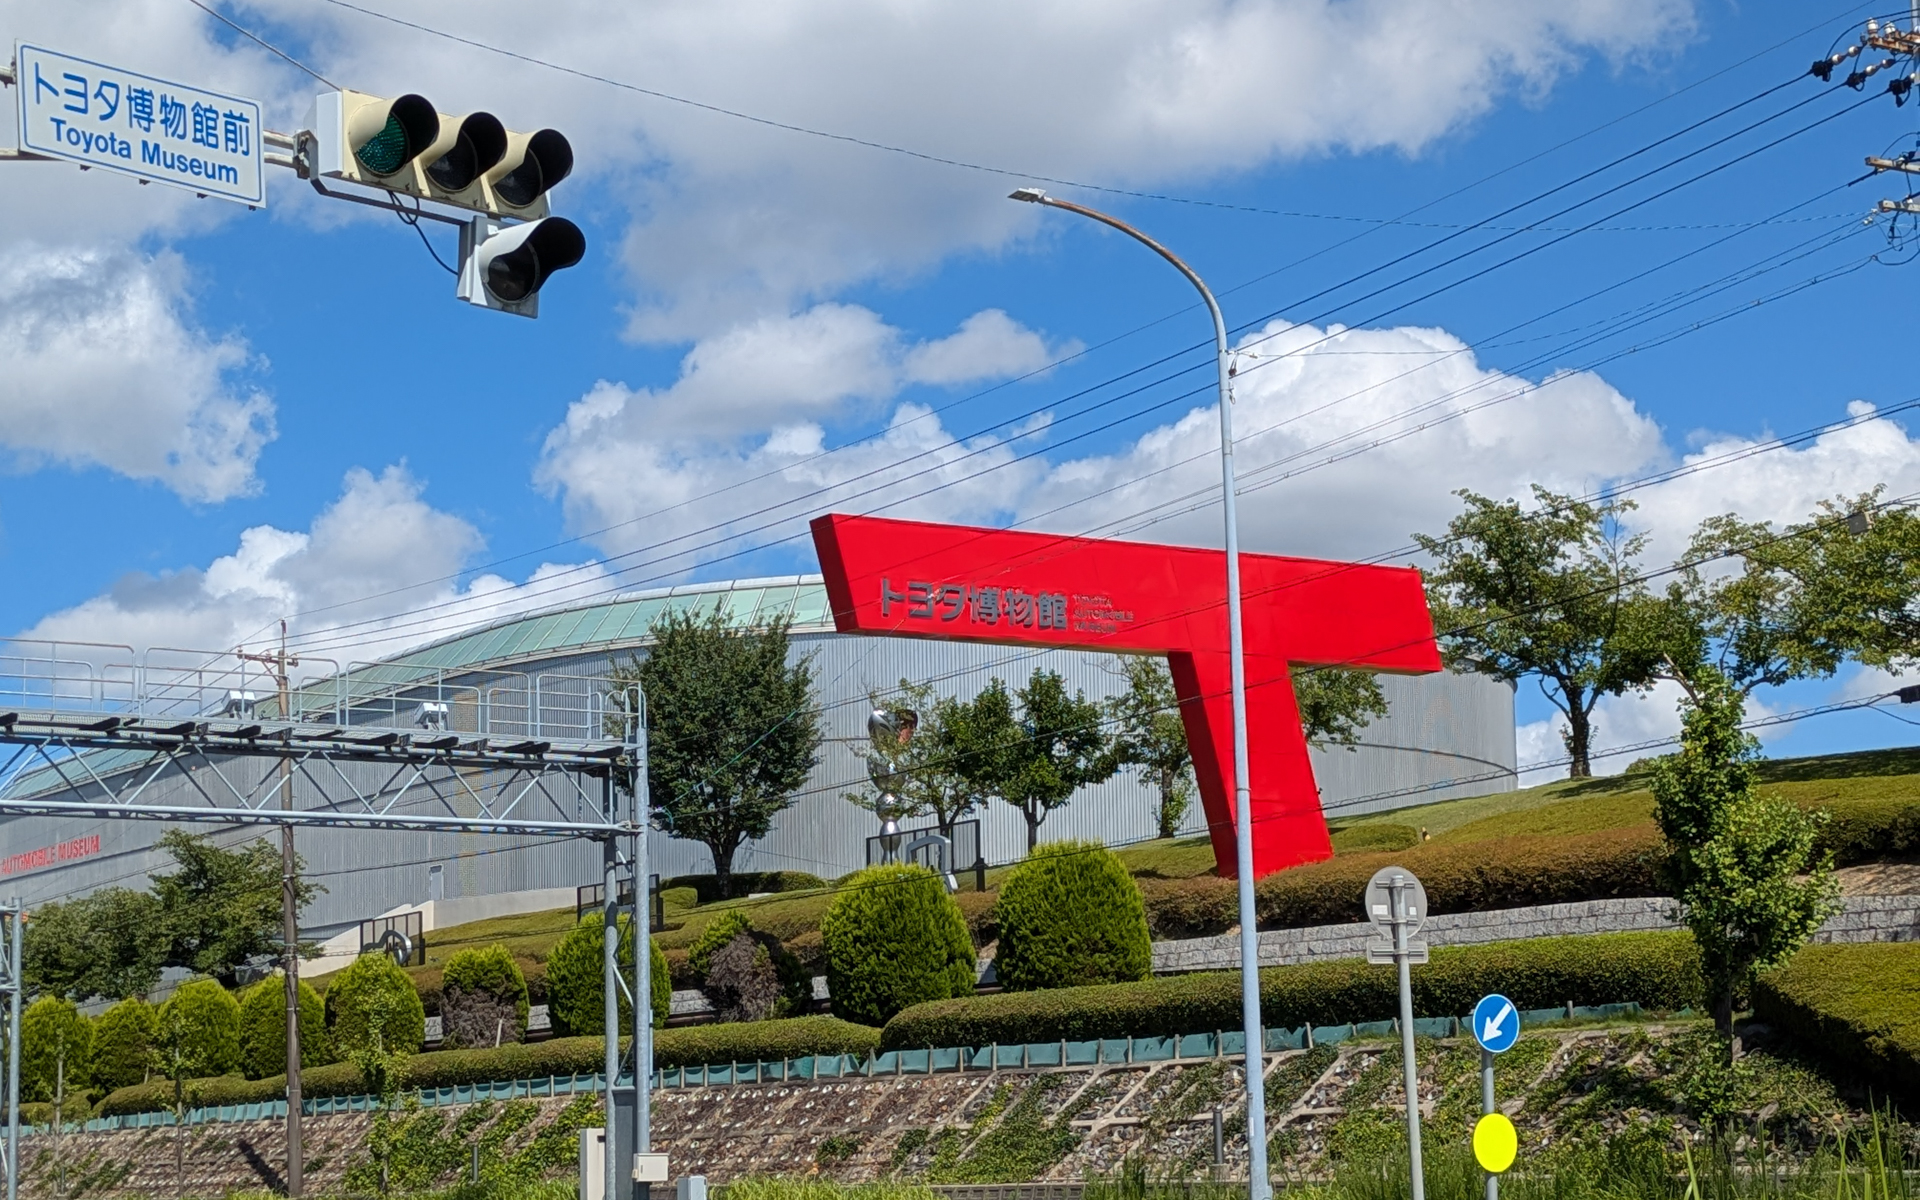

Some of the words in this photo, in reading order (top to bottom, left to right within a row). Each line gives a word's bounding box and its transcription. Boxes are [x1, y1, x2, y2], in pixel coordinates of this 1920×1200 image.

[35, 62, 250, 156] トヨタ博物館前
[50, 117, 132, 159] Toyota
[141, 140, 238, 185] Museum
[881, 577, 1068, 629] トヨタ博物館
[2, 846, 56, 874] AUTOMOBILE
[57, 834, 101, 861] MUSEUM
